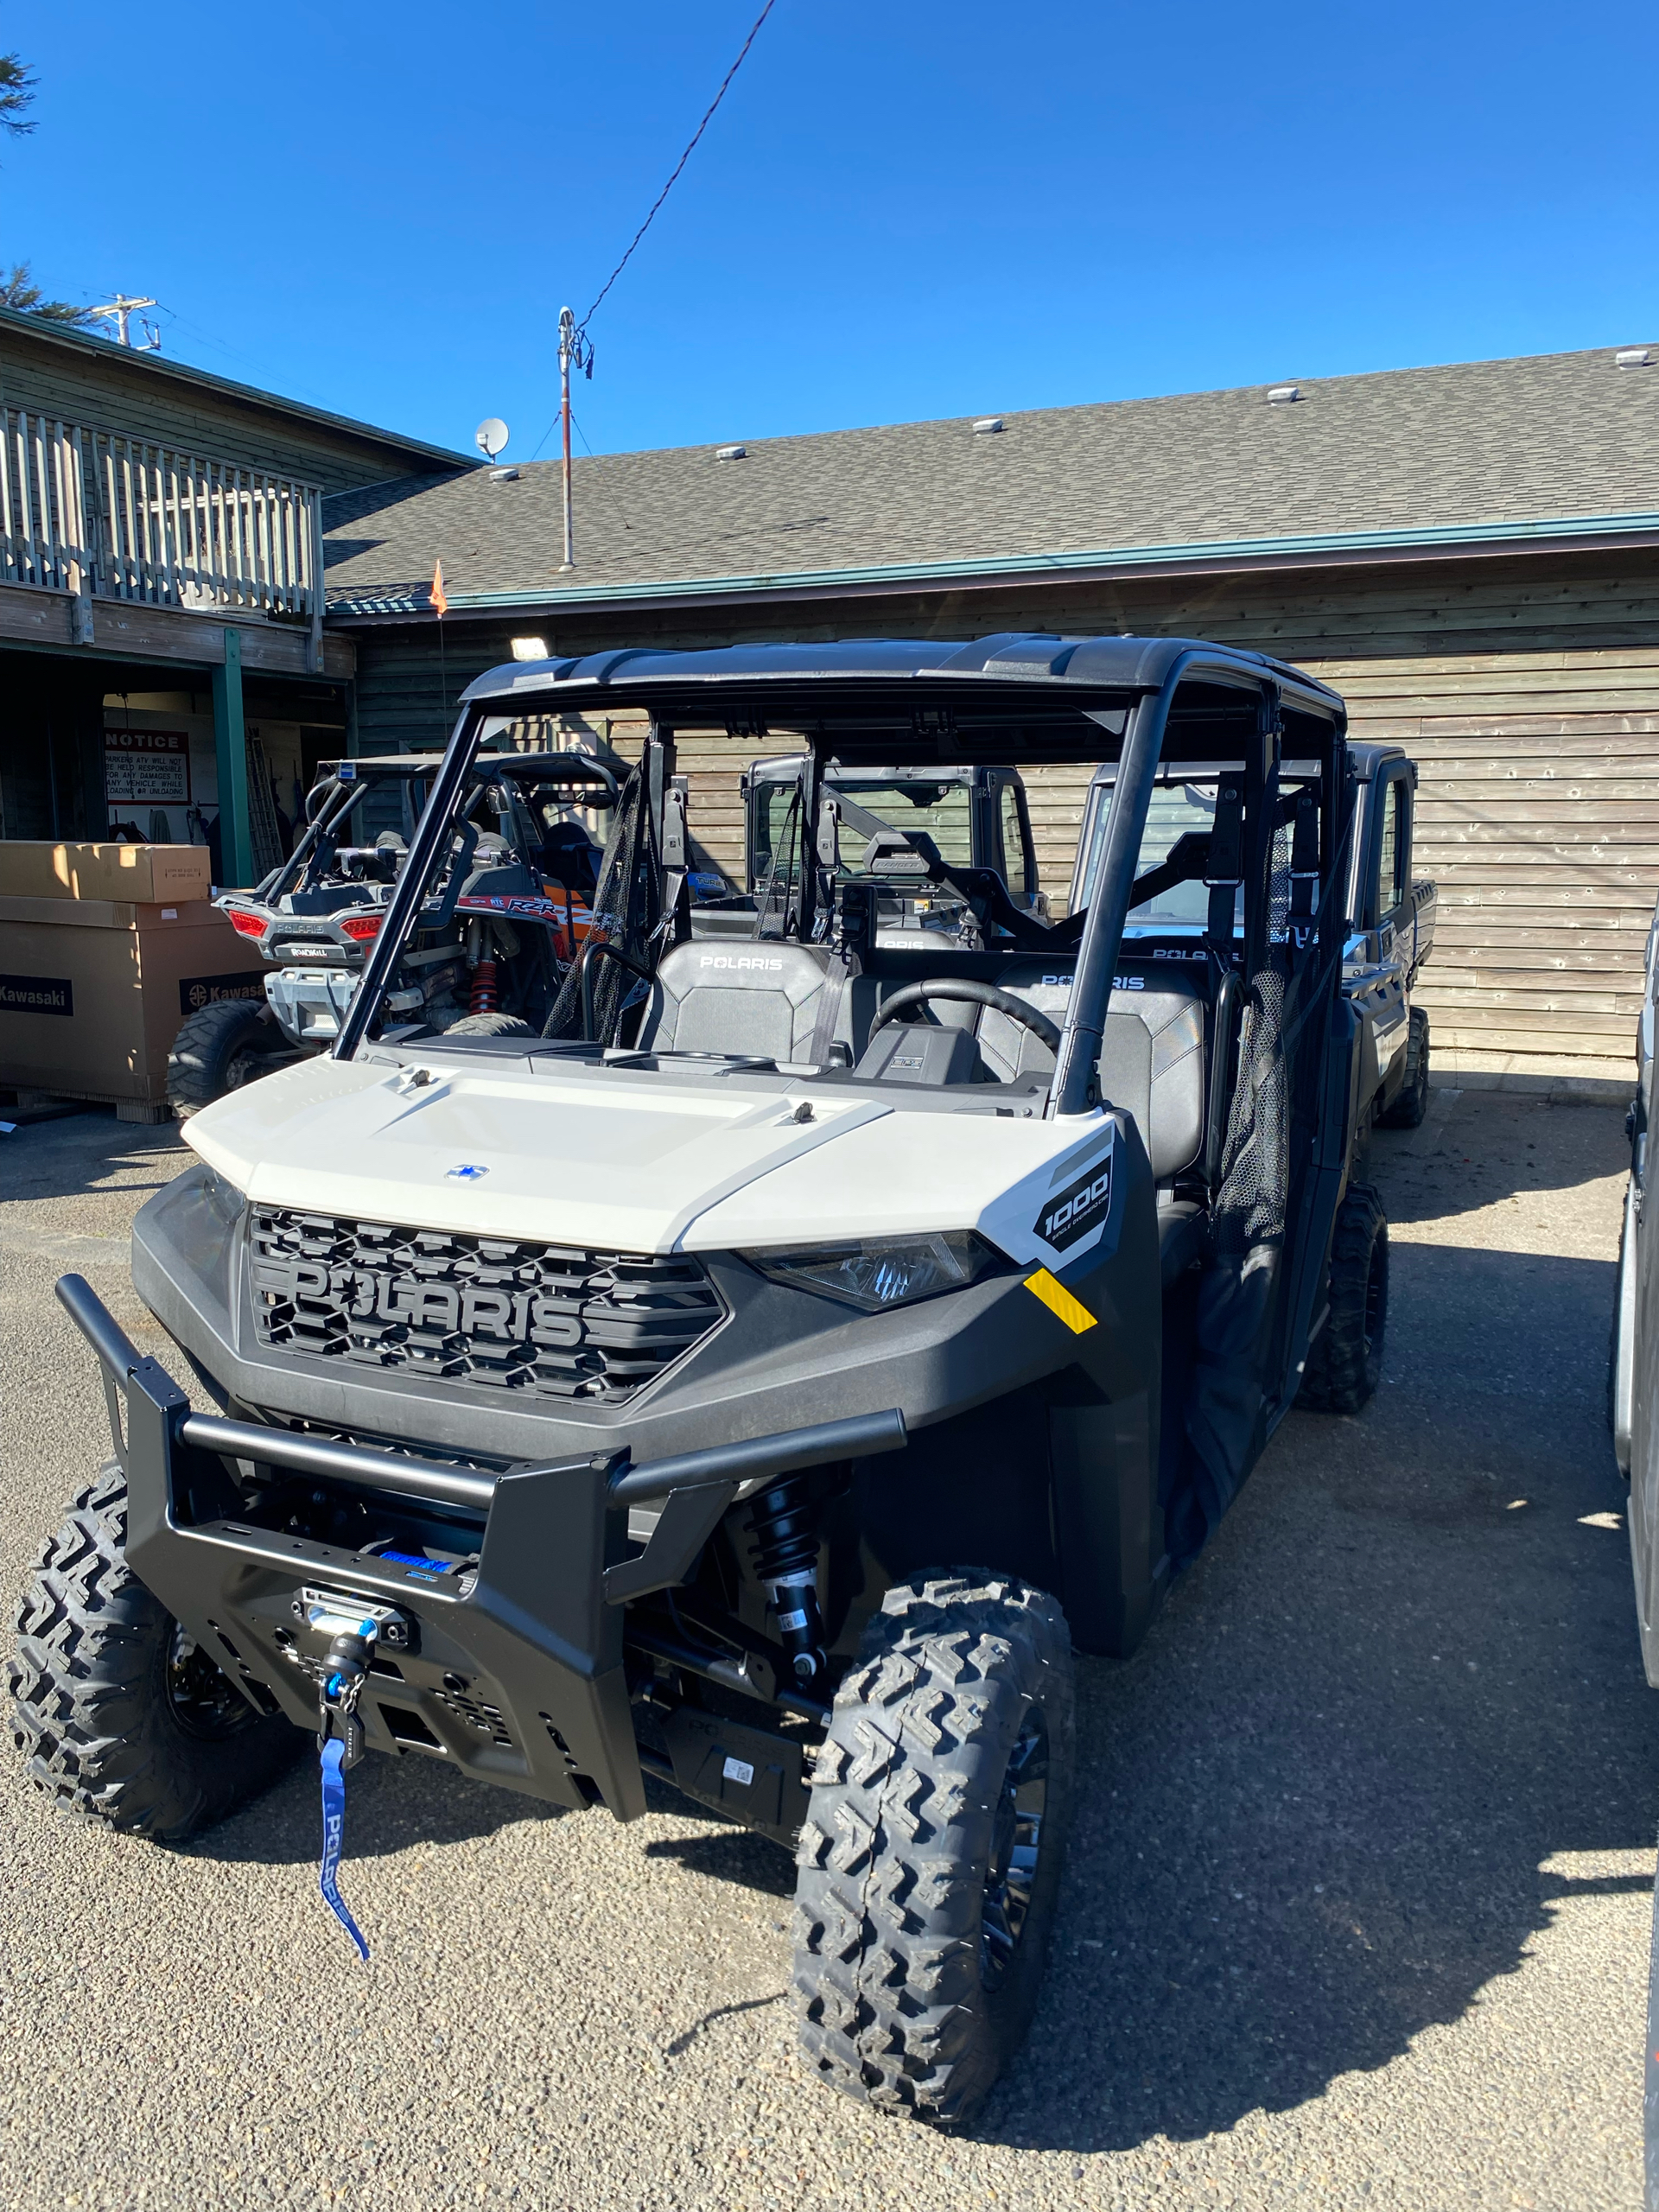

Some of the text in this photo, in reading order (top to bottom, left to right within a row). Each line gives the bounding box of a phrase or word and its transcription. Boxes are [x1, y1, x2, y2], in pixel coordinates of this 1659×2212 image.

[105, 733, 179, 748] NOTICE
[105, 755, 134, 764] PARKERS
[508, 899, 556, 915] RZR
[276, 924, 325, 934] POLARIS
[876, 940, 925, 950] ARIS
[700, 956, 783, 971] POLARIS
[1041, 975, 1145, 990] PORIS
[0, 985, 66, 1007] Kawasaki
[210, 984, 265, 1002] Kawasa
[1045, 1173, 1109, 1236] 1000
[1052, 1223, 1071, 1242] SINGLE
[1072, 1200, 1098, 1225] OVERHEAD
[287, 1260, 583, 1347] POLARIS
[322, 1814, 351, 1923] POLARIS
